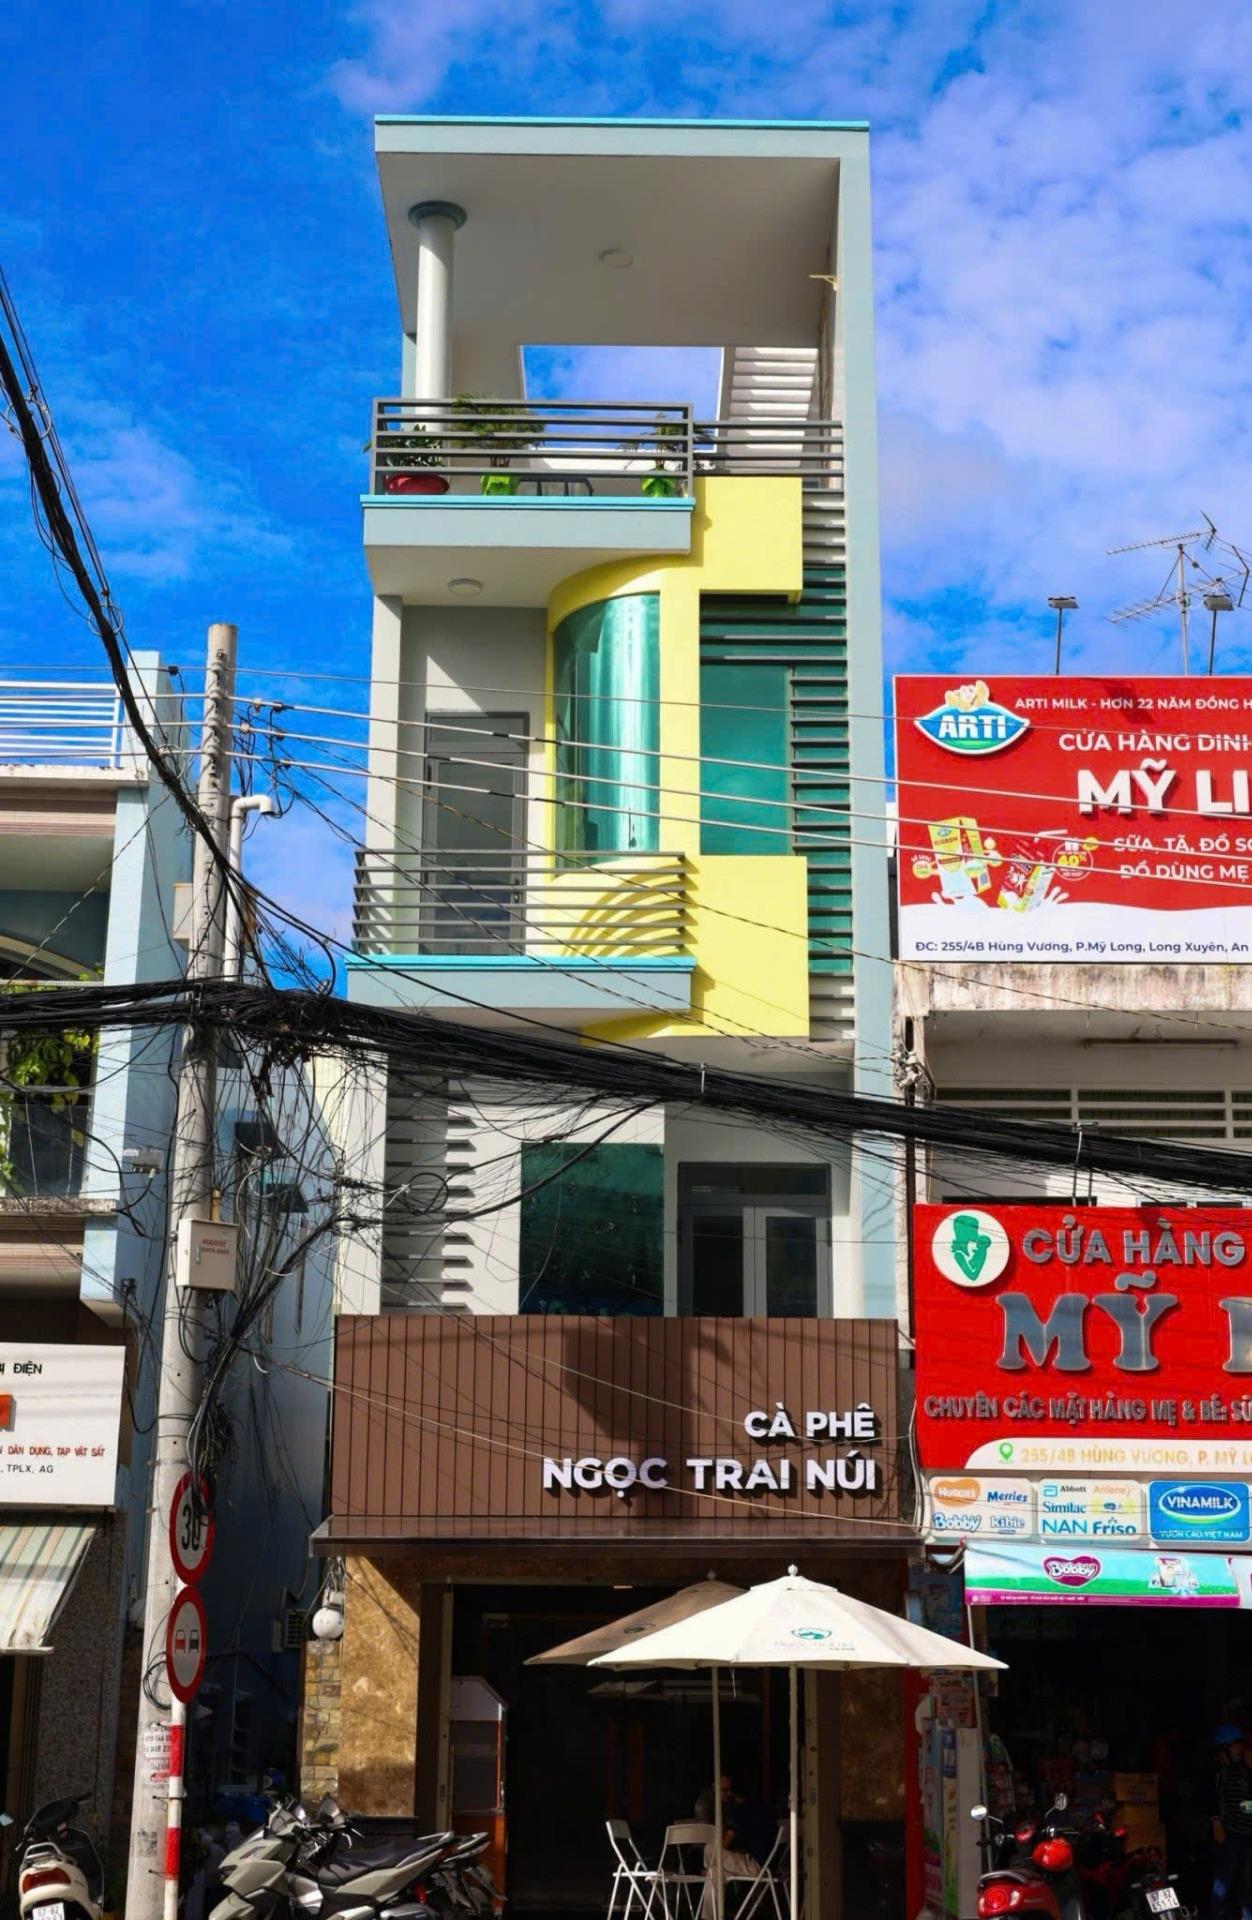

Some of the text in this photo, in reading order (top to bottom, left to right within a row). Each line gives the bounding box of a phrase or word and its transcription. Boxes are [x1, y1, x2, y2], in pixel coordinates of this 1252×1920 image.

[1014, 697, 1048, 709] ARTI
[1052, 698, 1088, 709] MILK
[1100, 697, 1133, 709] HƠN
[1137, 698, 1153, 709] 22
[1157, 696, 1191, 709] NĂM
[938, 714, 1006, 739] ARTI
[1059, 728, 1112, 751] CỬA
[1118, 730, 1191, 751] HÀNG
[1076, 758, 1176, 814] MỸ
[1156, 861, 1214, 879] DÙNG
[1219, 865, 1249, 882] MẸ
[916, 940, 1249, 954] ĐC: 255/4B Hùng Vương, P.Mỹ Long, Long Xuyên, An
[1022, 1215, 1246, 1266] CỬA HÀNG
[995, 1270, 1179, 1371] MỸ
[14, 1360, 43, 1377] ĐIỆN
[924, 1391, 998, 1419] CHUYÊN
[1003, 1391, 1045, 1419] CÁC
[1089, 1391, 1146, 1420] HÀNG
[1151, 1399, 1177, 1426] MẸ
[744, 1401, 875, 1438] CÀ PHÊ
[39, 1465, 54, 1473] AG
[542, 1450, 876, 1498] NGỌC TRAI NÚI
[987, 1490, 1028, 1503] Merries
[1060, 1485, 1087, 1493] Abbott
[1042, 1501, 1087, 1514] Similac
[1166, 1496, 1234, 1511] VINAMILK
[932, 1511, 982, 1533] Bobby
[1041, 1519, 1088, 1535] NAN
[1092, 1520, 1137, 1535] Friso
[1048, 1562, 1097, 1578] Bobby
